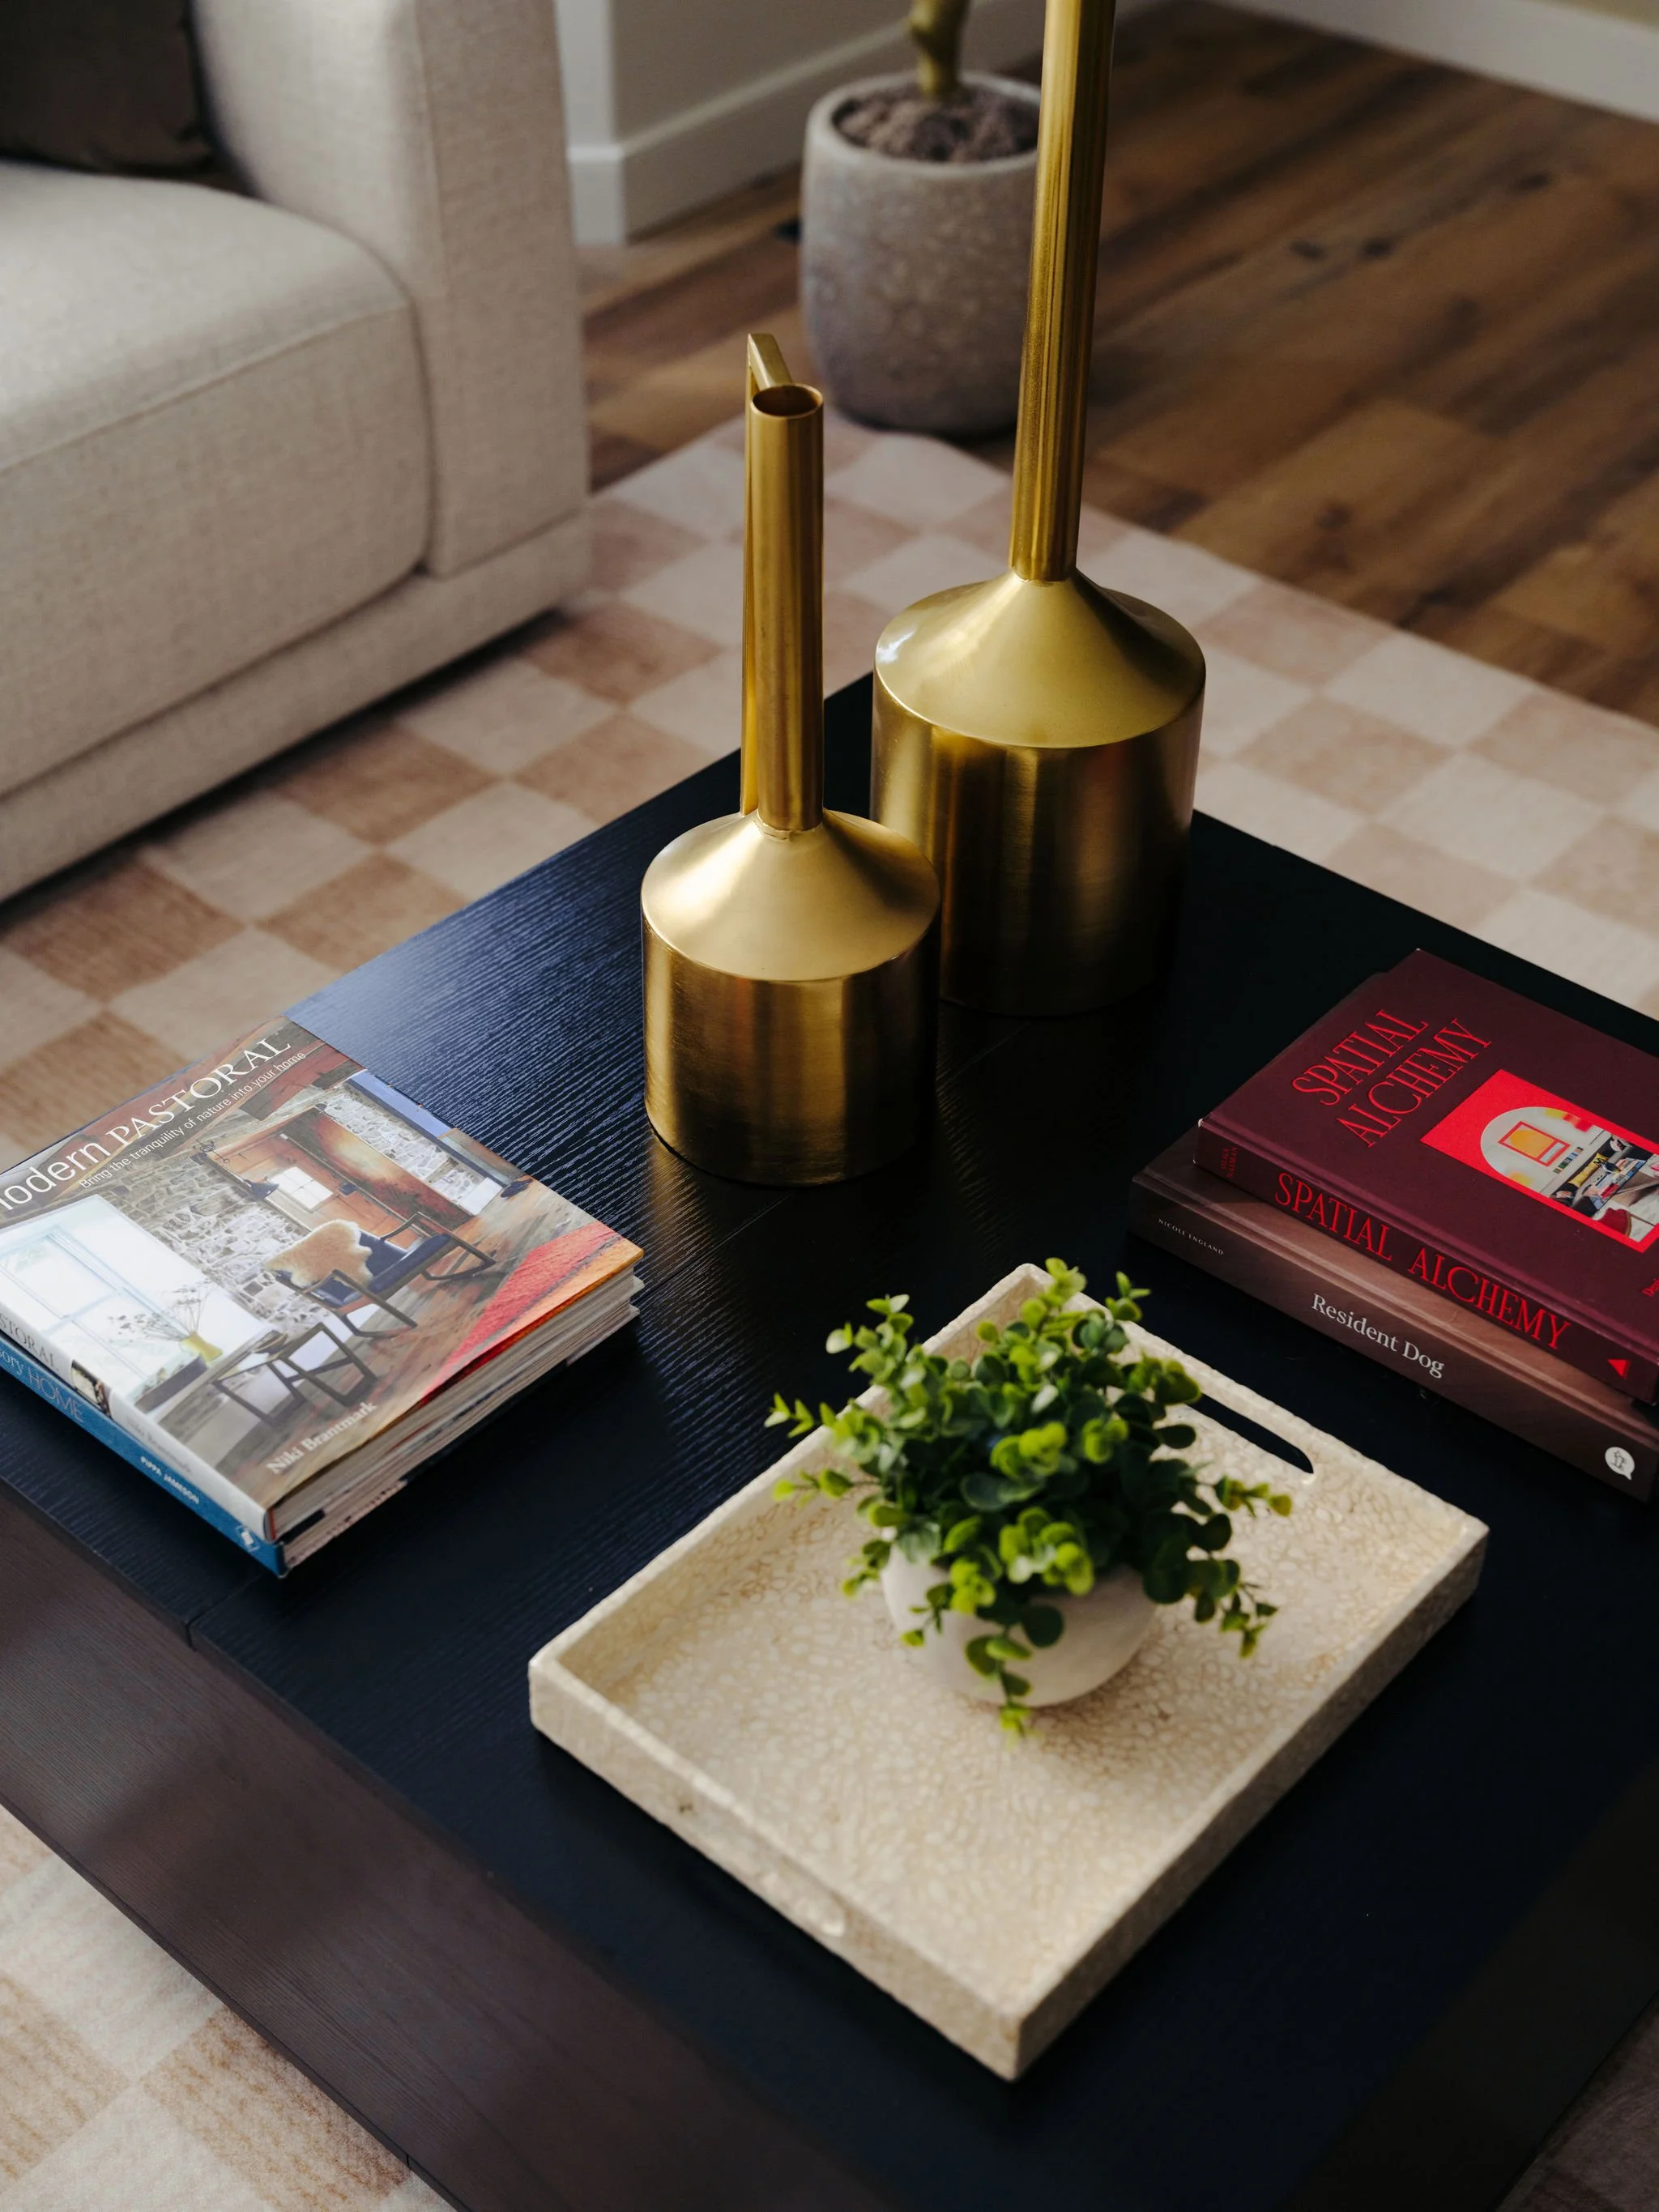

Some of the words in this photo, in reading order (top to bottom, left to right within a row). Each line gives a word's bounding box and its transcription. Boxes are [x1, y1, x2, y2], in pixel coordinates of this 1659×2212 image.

[1291, 1009, 1429, 1106] SPATIAL
[1336, 1018, 1492, 1148] ALCHEMY
[0, 1142, 112, 1211] odern
[105, 1038, 291, 1148] PASTORAL
[79, 1166, 112, 1189] Bring
[110, 1157, 131, 1172] the
[130, 1125, 186, 1160] tranquility
[184, 1117, 198, 1130] of
[197, 1098, 232, 1123] nature
[231, 1085, 253, 1102] into
[252, 1070, 277, 1088] your
[275, 1051, 306, 1072] home
[1188, 1233, 1224, 1255] ENGLAND
[1274, 1172, 1392, 1262] SPATIAL
[1407, 1247, 1572, 1350] ALCHEMY
[1311, 1293, 1399, 1352] Resident
[1402, 1340, 1444, 1379] Dog
[27, 1366, 84, 1424] HOME
[267, 1446, 305, 1474] Niki
